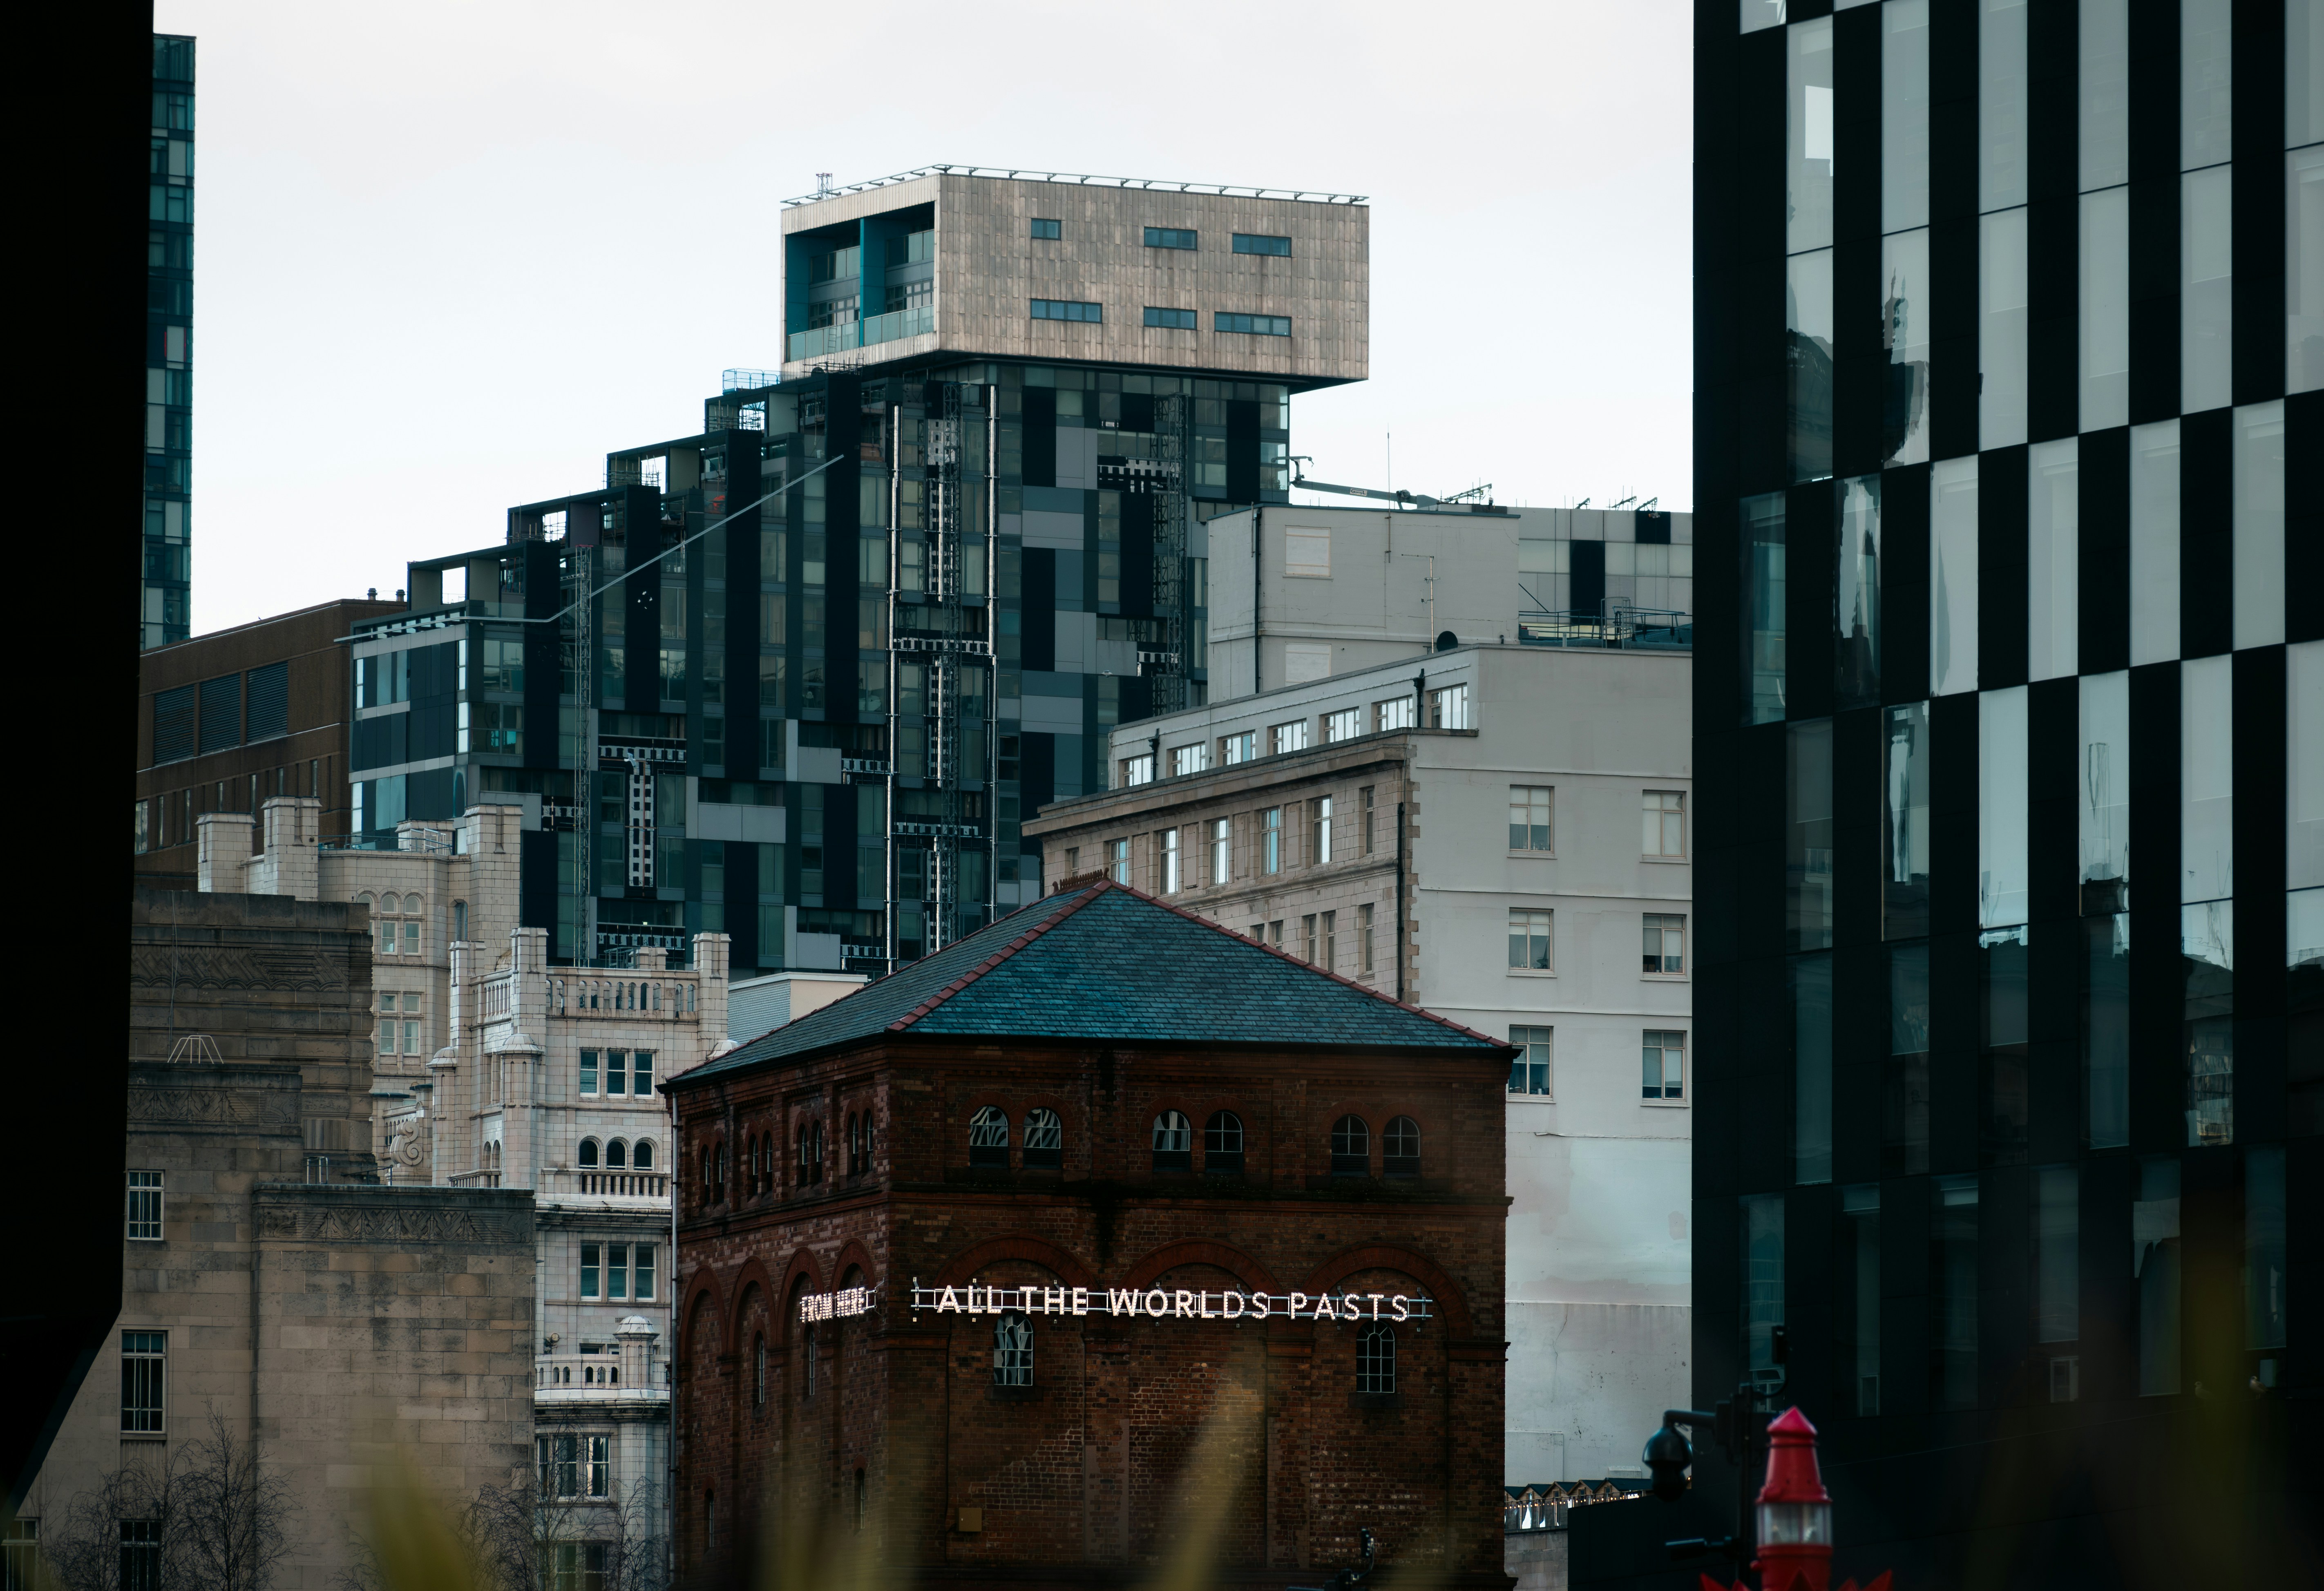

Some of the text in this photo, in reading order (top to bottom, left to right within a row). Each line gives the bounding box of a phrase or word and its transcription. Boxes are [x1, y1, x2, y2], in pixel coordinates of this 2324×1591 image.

[936, 1285, 1408, 1322] ALL THE WORLDS PASTS
